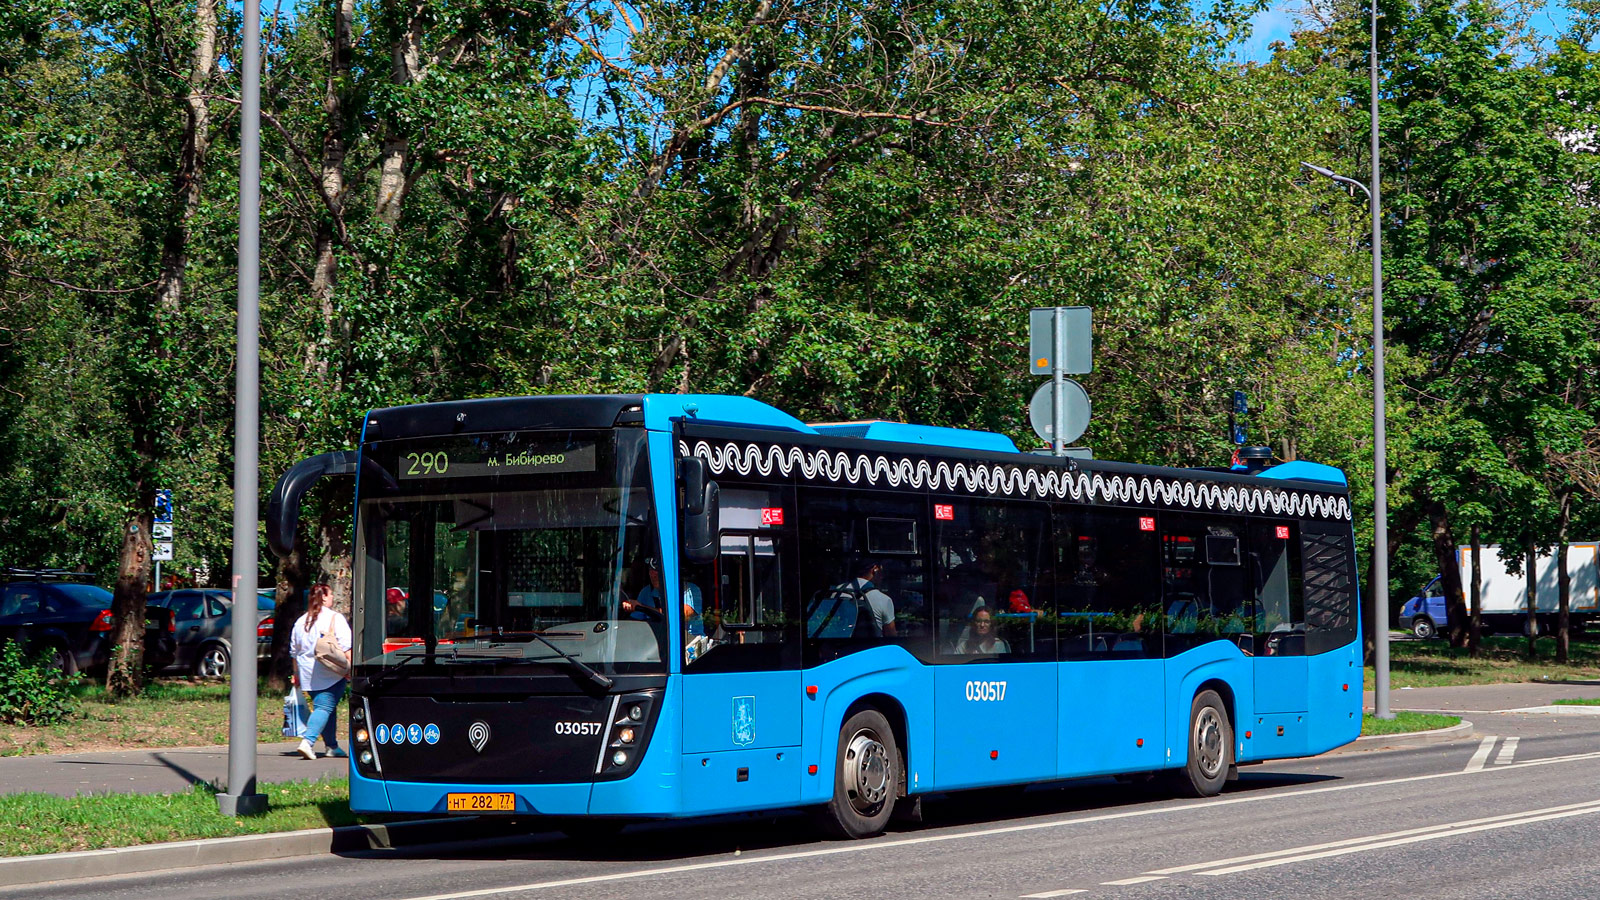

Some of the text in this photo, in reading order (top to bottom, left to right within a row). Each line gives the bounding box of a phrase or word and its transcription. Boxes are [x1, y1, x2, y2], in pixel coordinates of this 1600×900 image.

[407, 451, 565, 475] 290 м. Бибирево
[965, 680, 1007, 702] 030517
[555, 721, 602, 736] 030517
[471, 795, 493, 809] 282
[499, 794, 511, 805] 77
